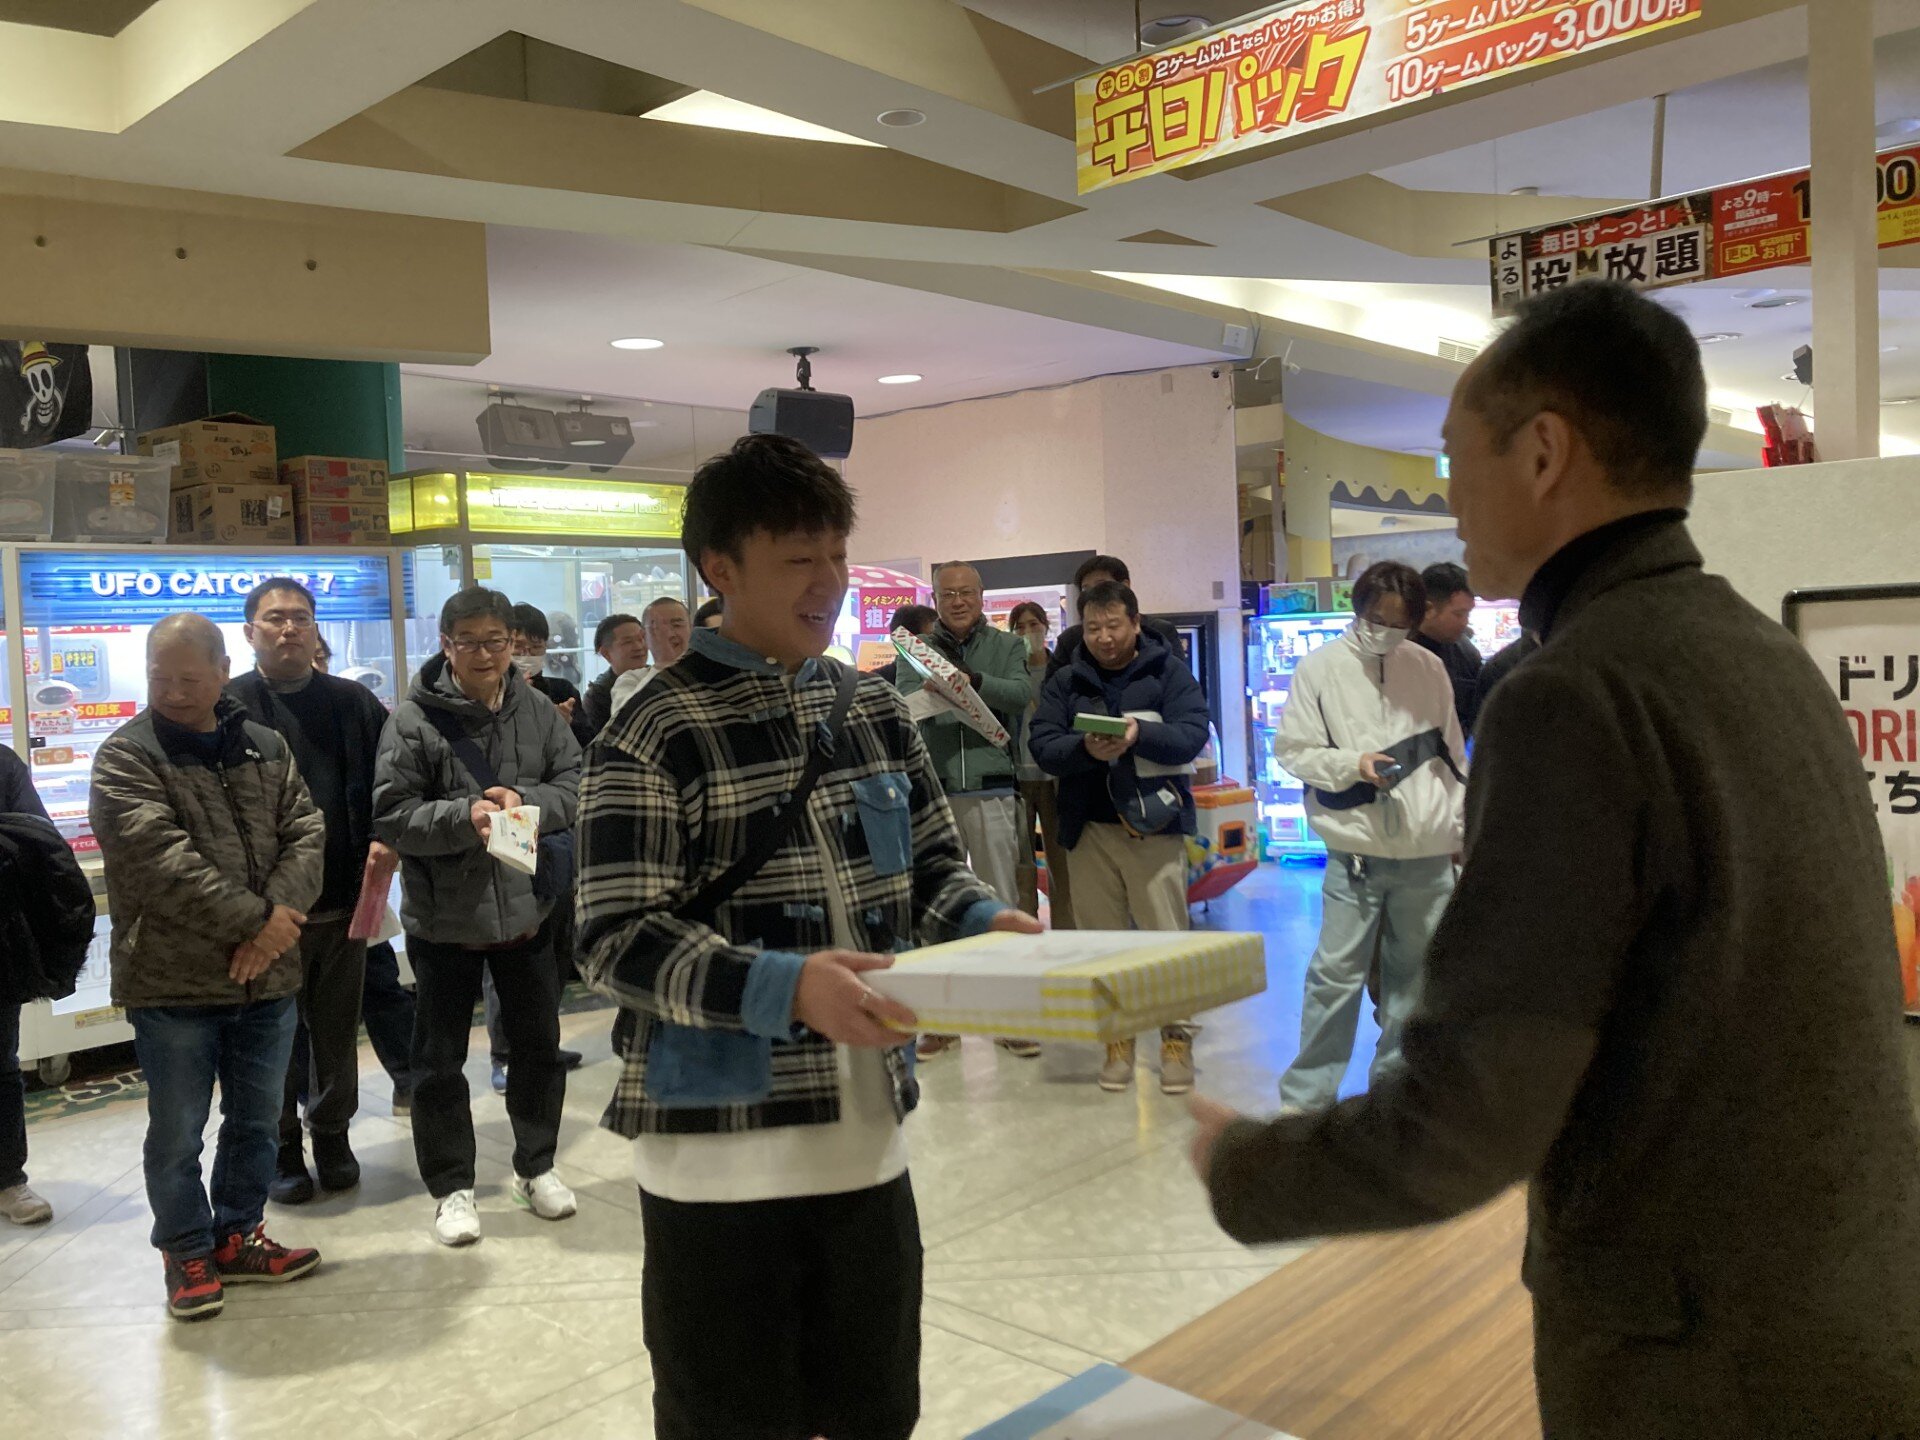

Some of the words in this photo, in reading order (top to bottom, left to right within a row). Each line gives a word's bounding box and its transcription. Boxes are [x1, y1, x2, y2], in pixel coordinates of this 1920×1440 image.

[1406, 0, 1547, 48] 5ゲームパッ
[1093, 30, 1367, 171] 平日パック
[91, 572, 162, 597] UFO
[320, 573, 336, 594] 7
[863, 595, 914, 606] タイミングよく
[1840, 655, 1919, 701] ドリ
[1866, 770, 1920, 814] ち
